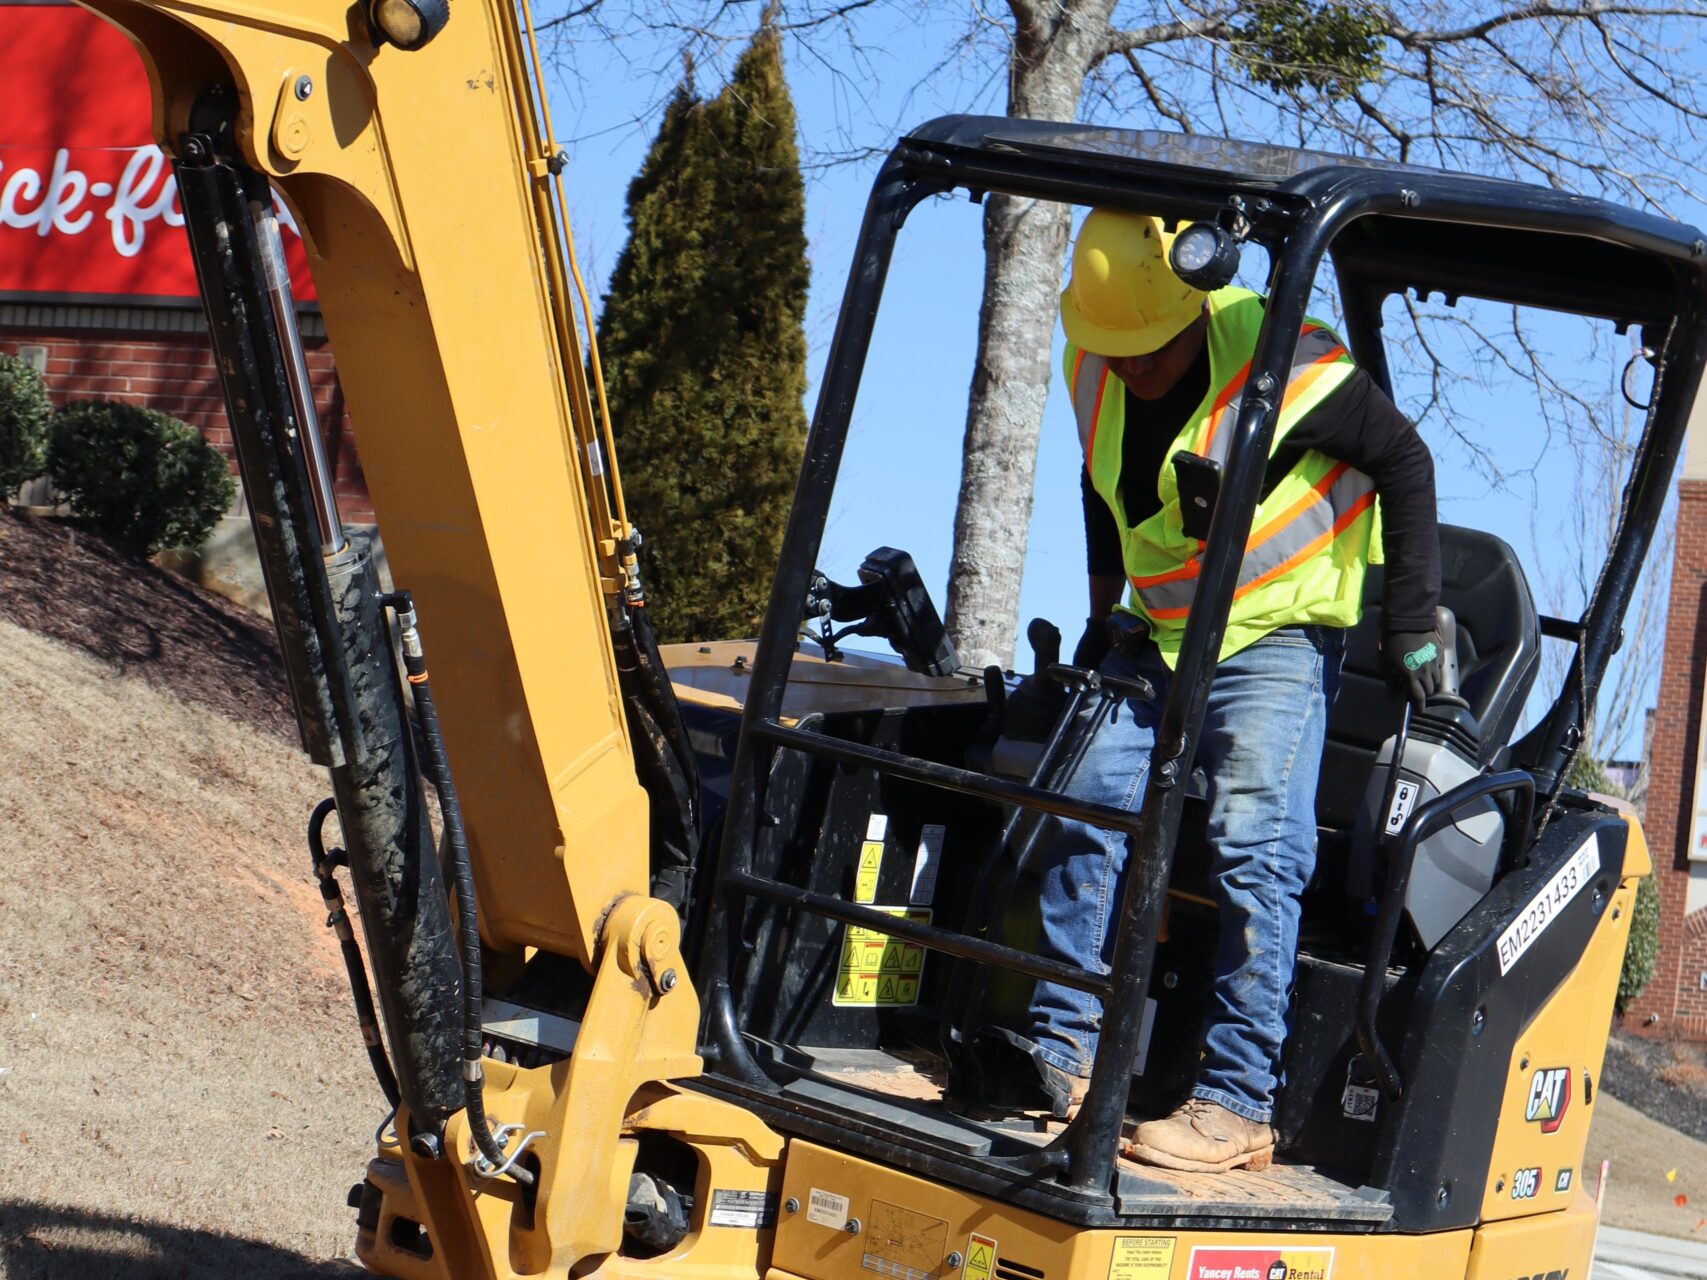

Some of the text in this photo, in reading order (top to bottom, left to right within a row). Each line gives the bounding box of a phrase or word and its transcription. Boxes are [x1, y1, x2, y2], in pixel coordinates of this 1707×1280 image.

[1499, 866, 1577, 968] EM2231433
[1526, 1068, 1568, 1121] CAT
[1511, 1168, 1538, 1198] 305
[1121, 1238, 1171, 1246] BEFORE STARTING
[1233, 1265, 1261, 1279] Rents
[1269, 1267, 1286, 1280] CAT
[1288, 1268, 1325, 1280] Rental
